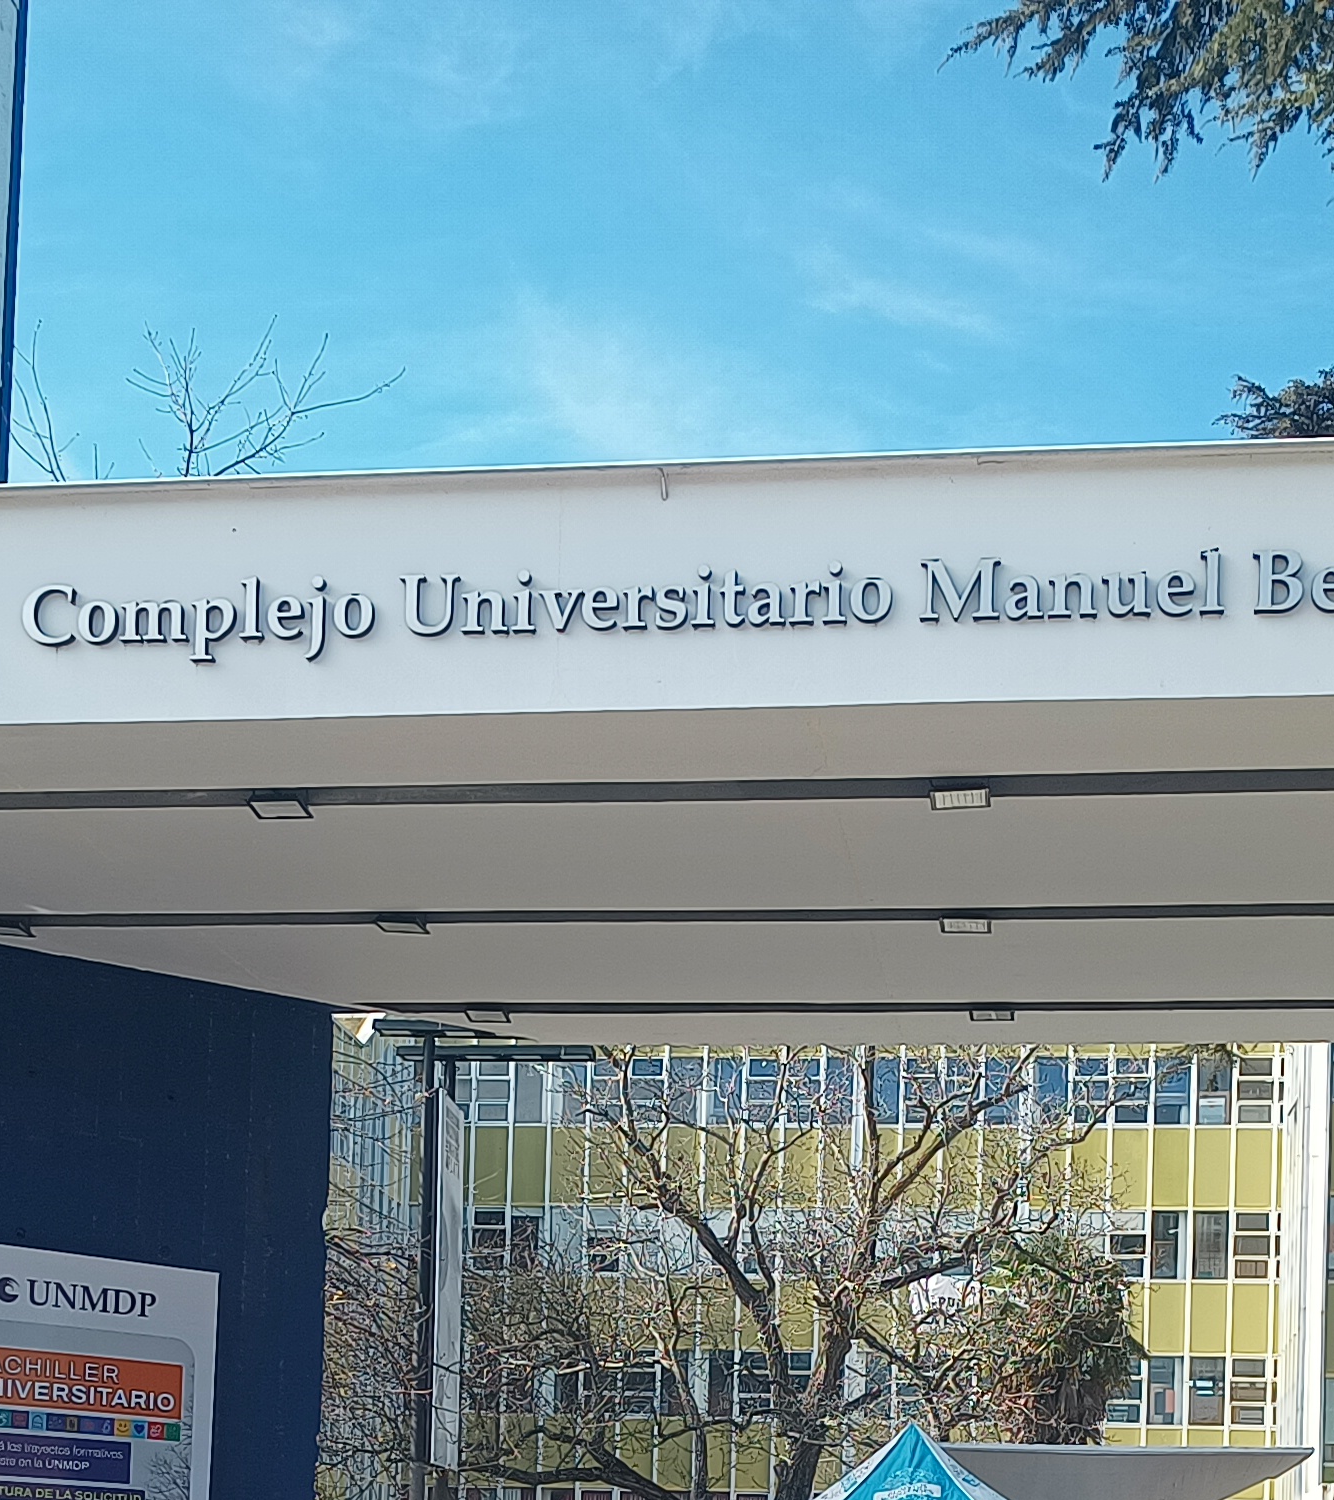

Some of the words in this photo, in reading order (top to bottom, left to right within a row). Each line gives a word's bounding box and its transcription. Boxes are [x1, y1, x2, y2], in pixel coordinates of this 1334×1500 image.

[22, 575, 376, 665] Complejo
[400, 562, 895, 639] Universitario
[919, 547, 1225, 625] Manuel
[26, 1278, 157, 1318] UNMDP
[7, 1441, 22, 1452] los
[24, 1442, 71, 1457] trayectos
[73, 1444, 124, 1460] formativos
[18, 1458, 33, 1467] en
[33, 1457, 43, 1468] la
[45, 1460, 90, 1471] UNMDP
[35, 1488, 54, 1499] DE
[55, 1489, 71, 1500] LA
